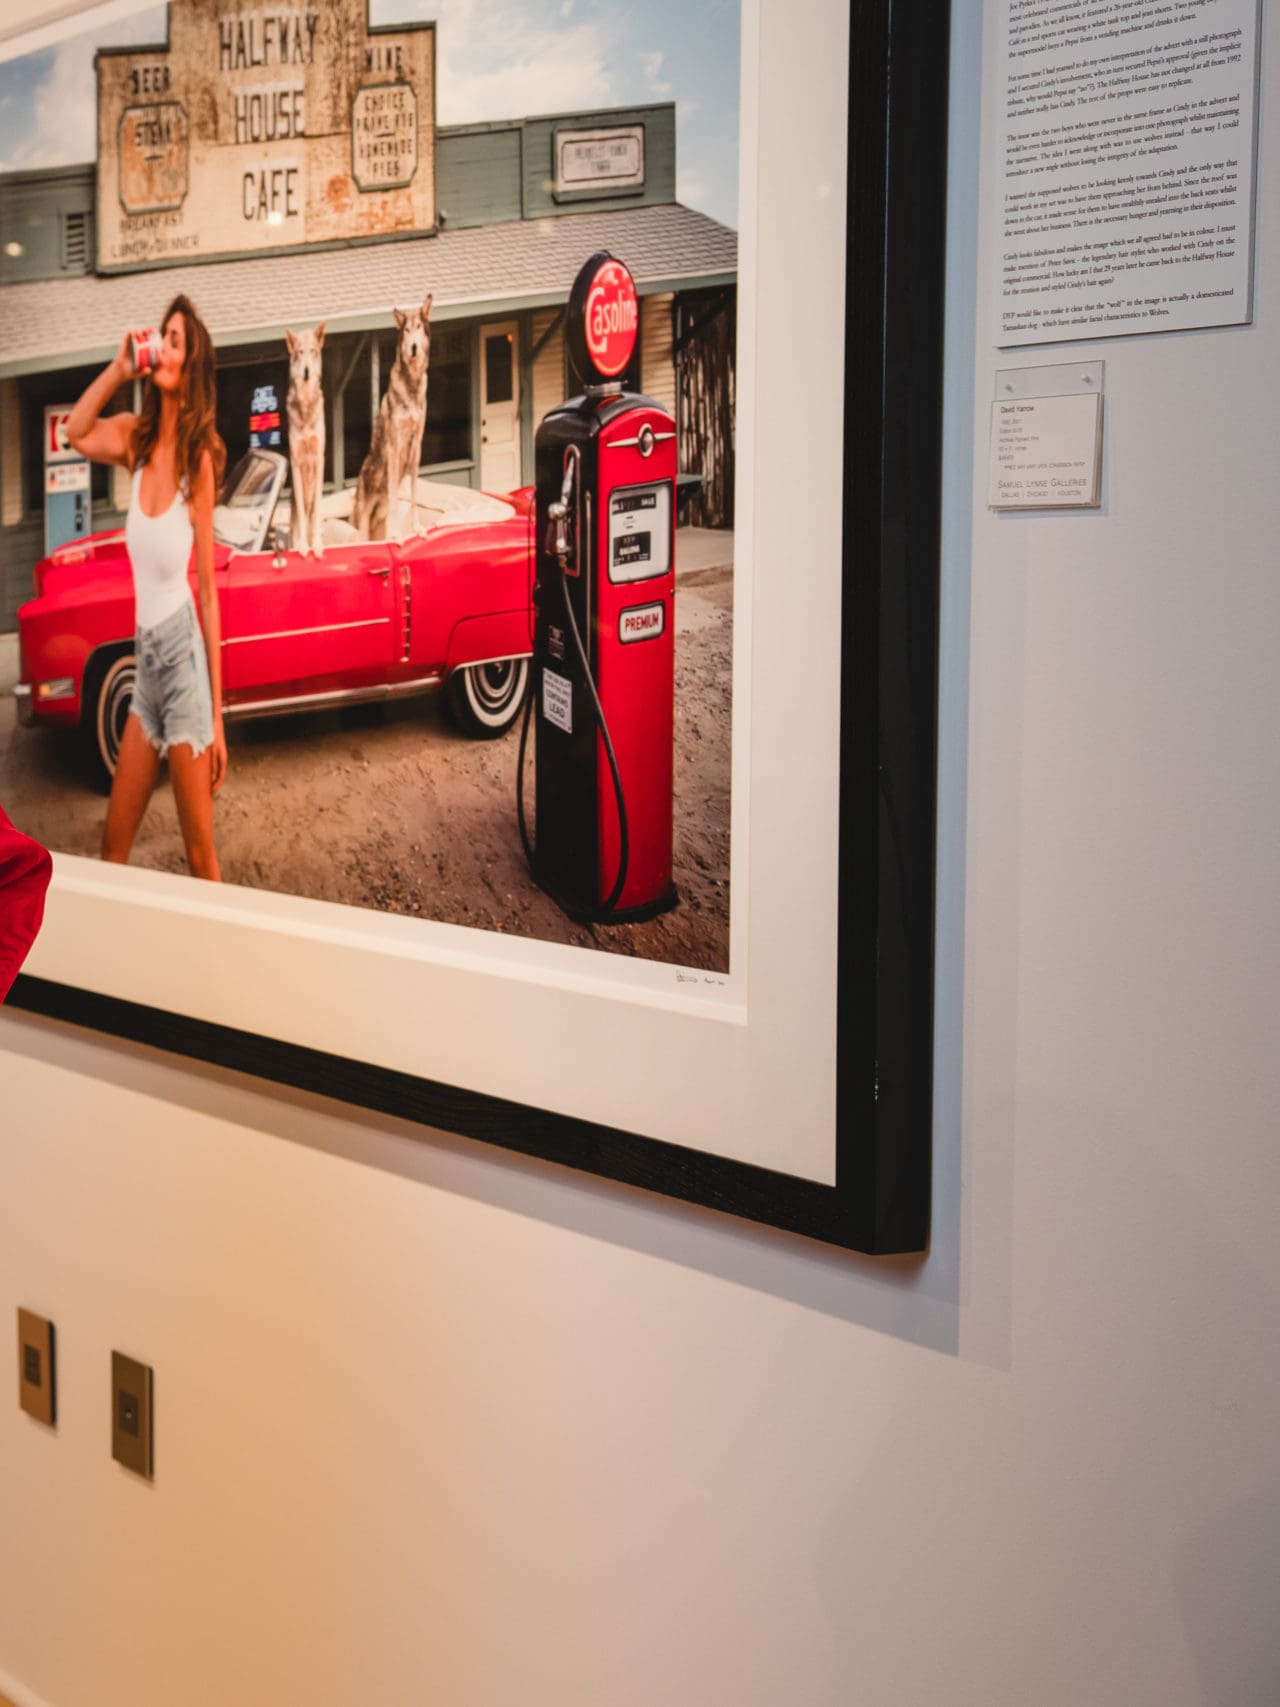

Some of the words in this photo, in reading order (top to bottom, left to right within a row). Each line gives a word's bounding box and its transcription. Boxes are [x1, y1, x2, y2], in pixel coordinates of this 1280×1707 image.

[219, 14, 320, 71] HALFWAY
[1208, 28, 1241, 44] photograph
[1131, 74, 1149, 82] House
[1227, 54, 1240, 64] 1992
[131, 66, 170, 95] BEER
[1173, 103, 1189, 112] Cindy
[234, 90, 305, 145] HOUSE
[1156, 115, 1188, 130] photograph
[1158, 169, 1174, 178] Cindy
[243, 168, 299, 221] CAFE
[1197, 239, 1213, 248] Cindy
[1003, 252, 1017, 261] Cindy
[1216, 251, 1234, 259] House
[624, 612, 659, 632] PREMIUM
[549, 701, 565, 719] LEAD
